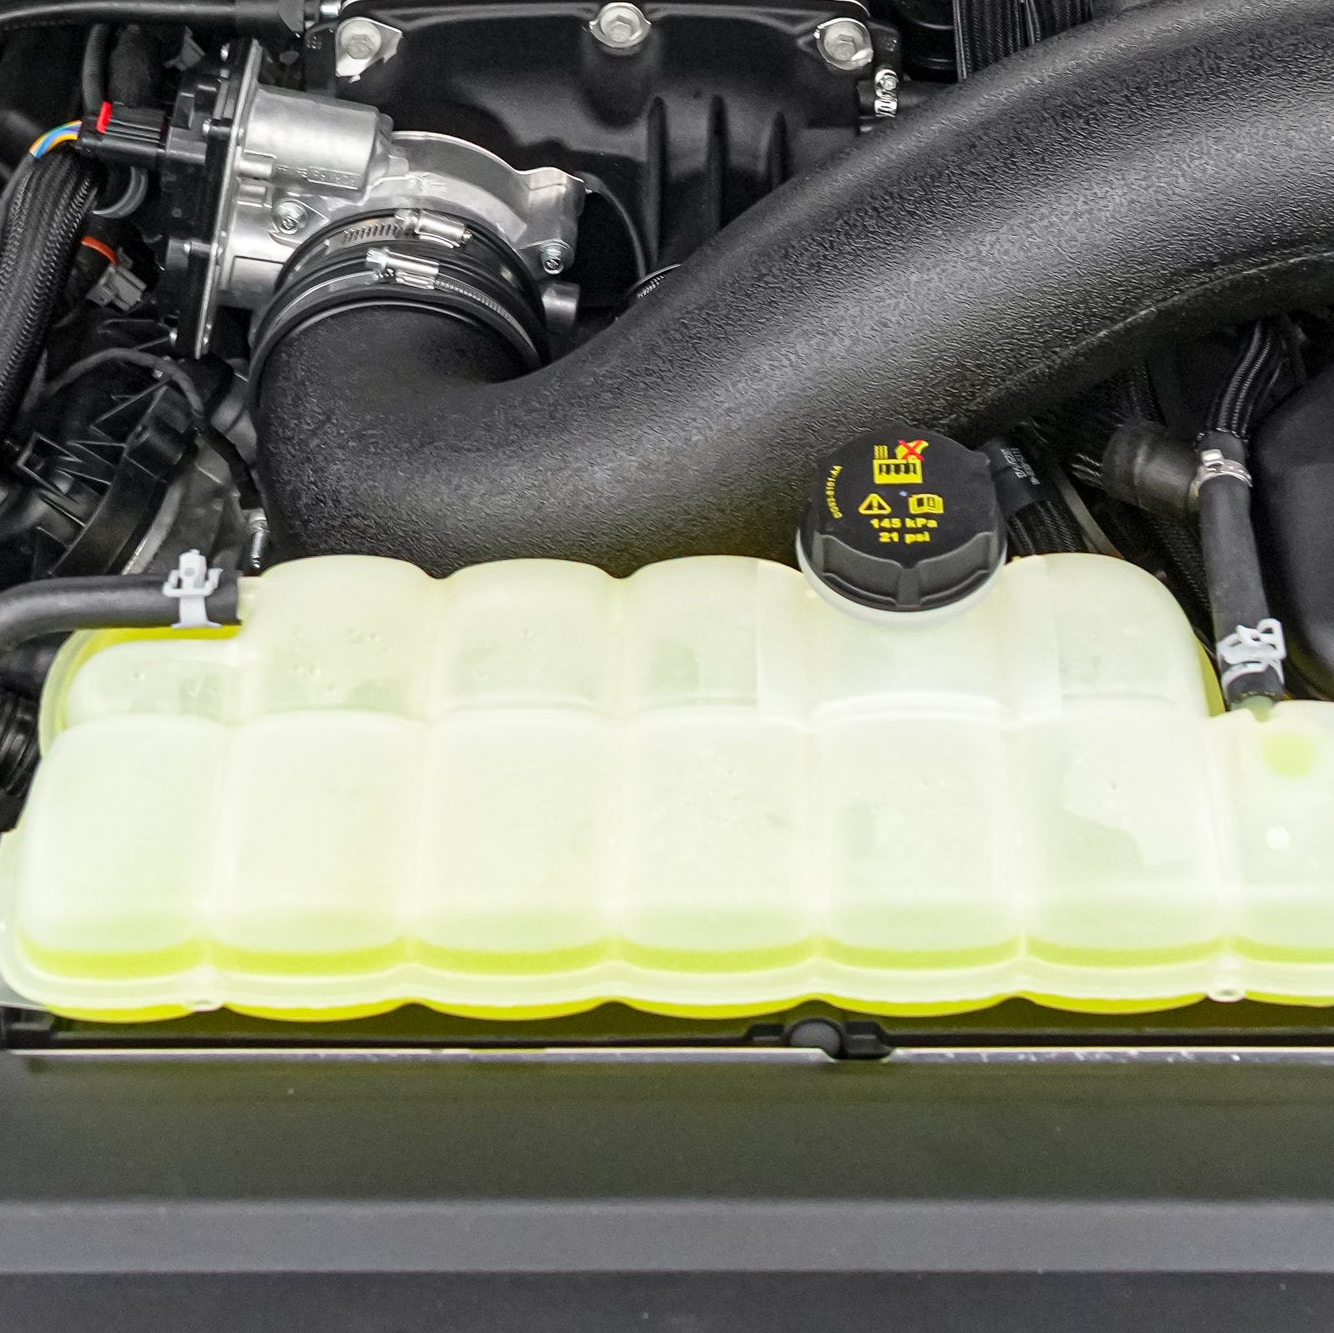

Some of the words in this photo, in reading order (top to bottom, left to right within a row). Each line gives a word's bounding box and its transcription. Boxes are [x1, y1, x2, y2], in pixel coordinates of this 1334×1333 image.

[870, 518, 902, 529] 145
[905, 518, 938, 529] kPa
[878, 532, 900, 543] 21
[904, 531, 931, 544] psi
